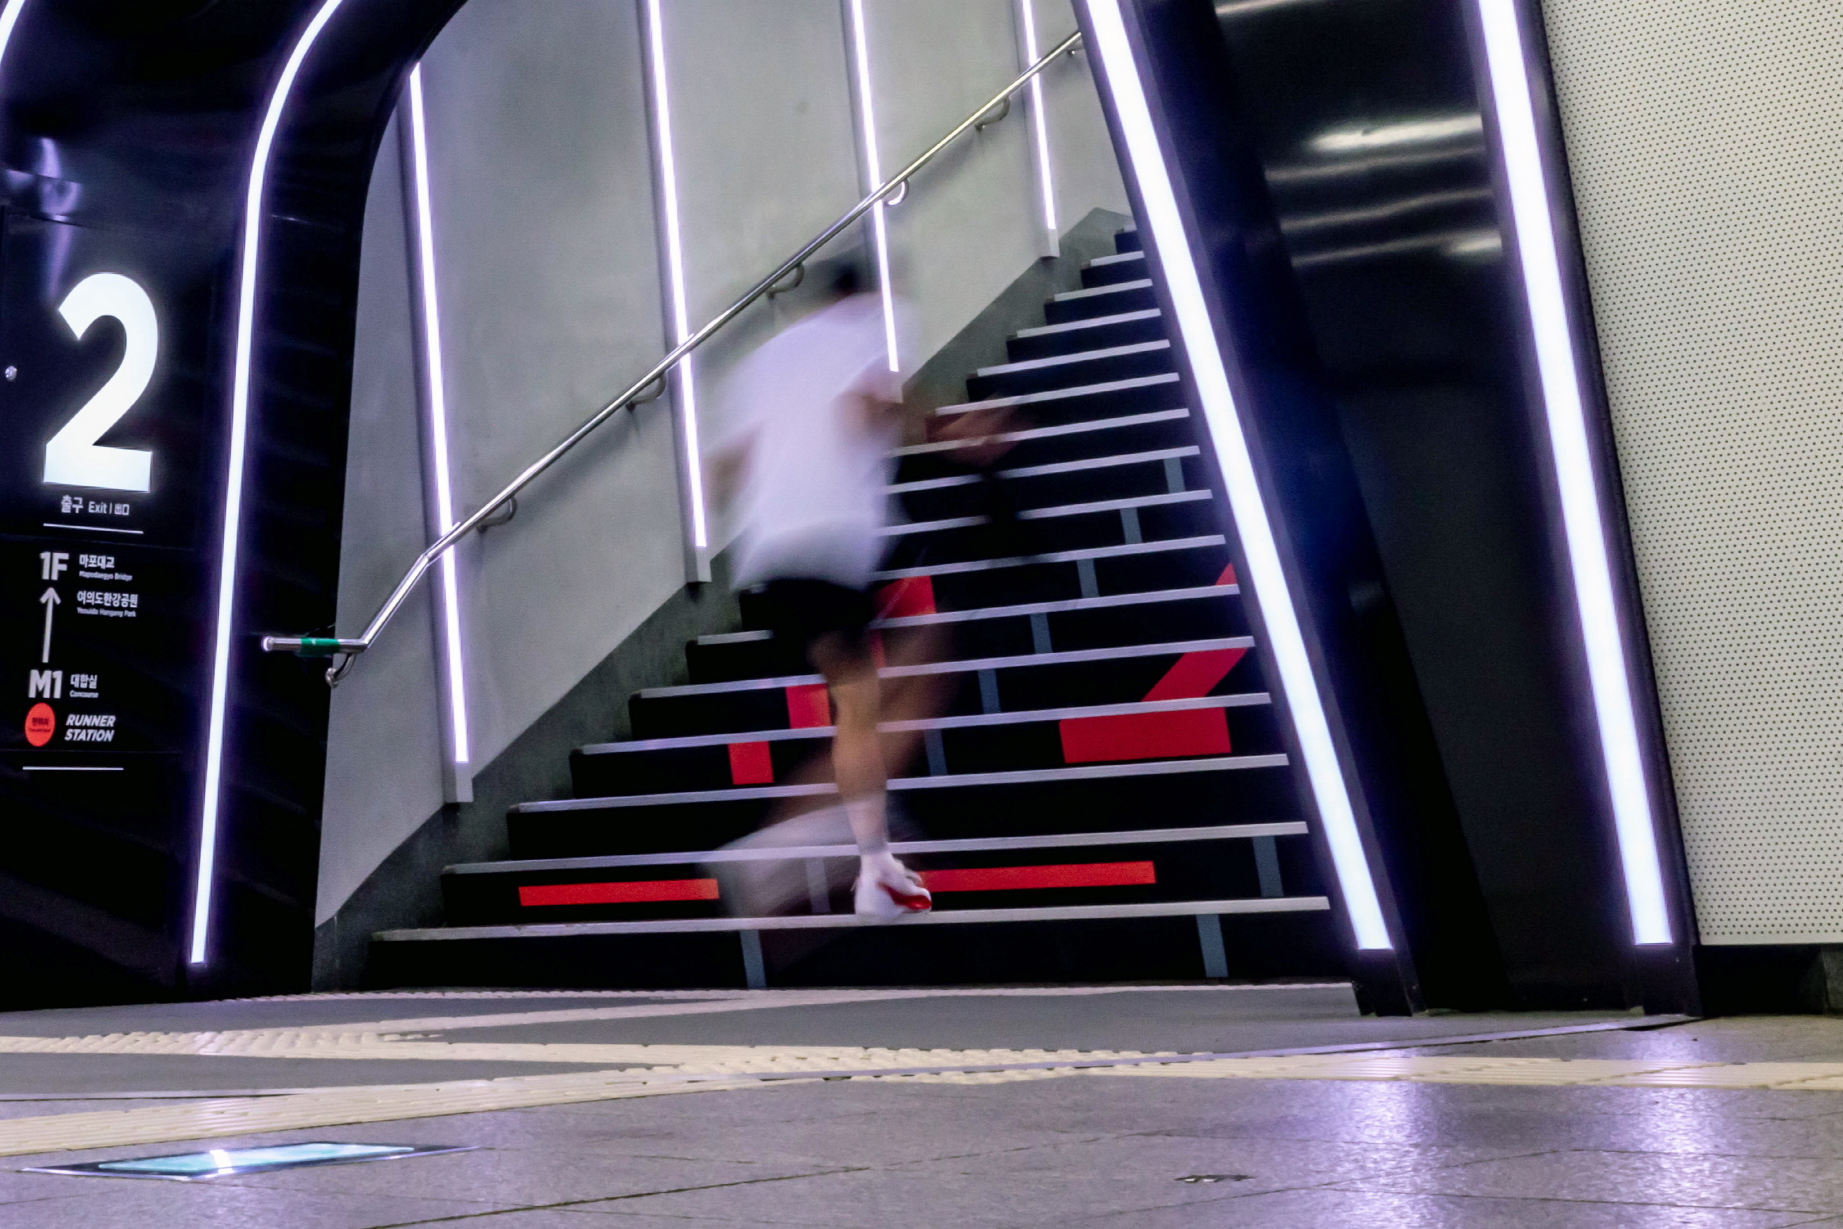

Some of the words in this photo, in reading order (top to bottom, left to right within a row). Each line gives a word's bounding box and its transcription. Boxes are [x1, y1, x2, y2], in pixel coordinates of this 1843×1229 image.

[43, 272, 158, 492] 2
[61, 495, 83, 514] 출구
[88, 501, 107, 514] Exit
[39, 551, 70, 581] 1F
[78, 554, 115, 570] 마포대교
[114, 572, 133, 582] Bridge
[77, 590, 139, 608] 여의도한강공원
[124, 610, 137, 618] Park
[28, 669, 63, 699] M1
[70, 673, 98, 689] 대합실
[69, 689, 99, 699] Concourse
[65, 714, 117, 728] RUNNER
[64, 728, 115, 742] STATION
